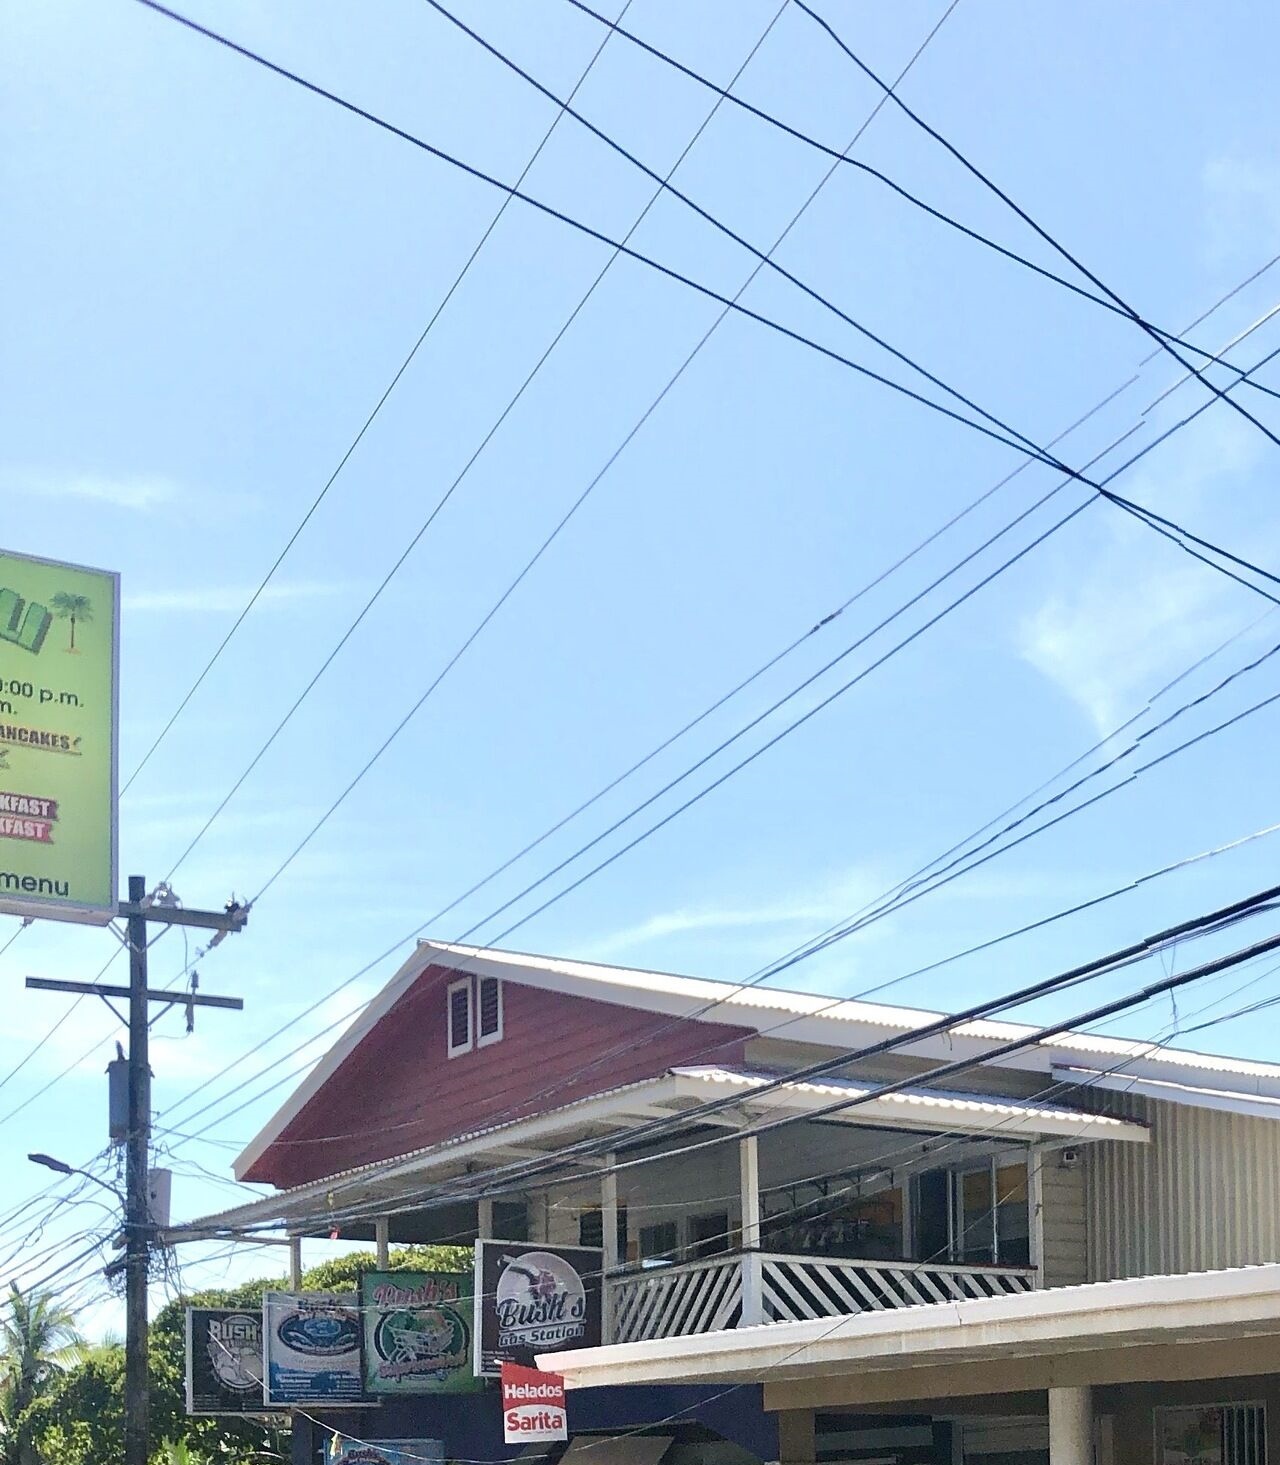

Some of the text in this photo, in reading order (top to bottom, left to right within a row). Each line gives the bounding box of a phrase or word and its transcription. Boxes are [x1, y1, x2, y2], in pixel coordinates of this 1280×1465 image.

[0, 678, 84, 708] :00 p.m.
[0, 872, 69, 897] menu
[499, 1324, 585, 1347] Gas Station
[504, 1383, 563, 1399] Helados
[507, 1412, 563, 1432] Sarita
